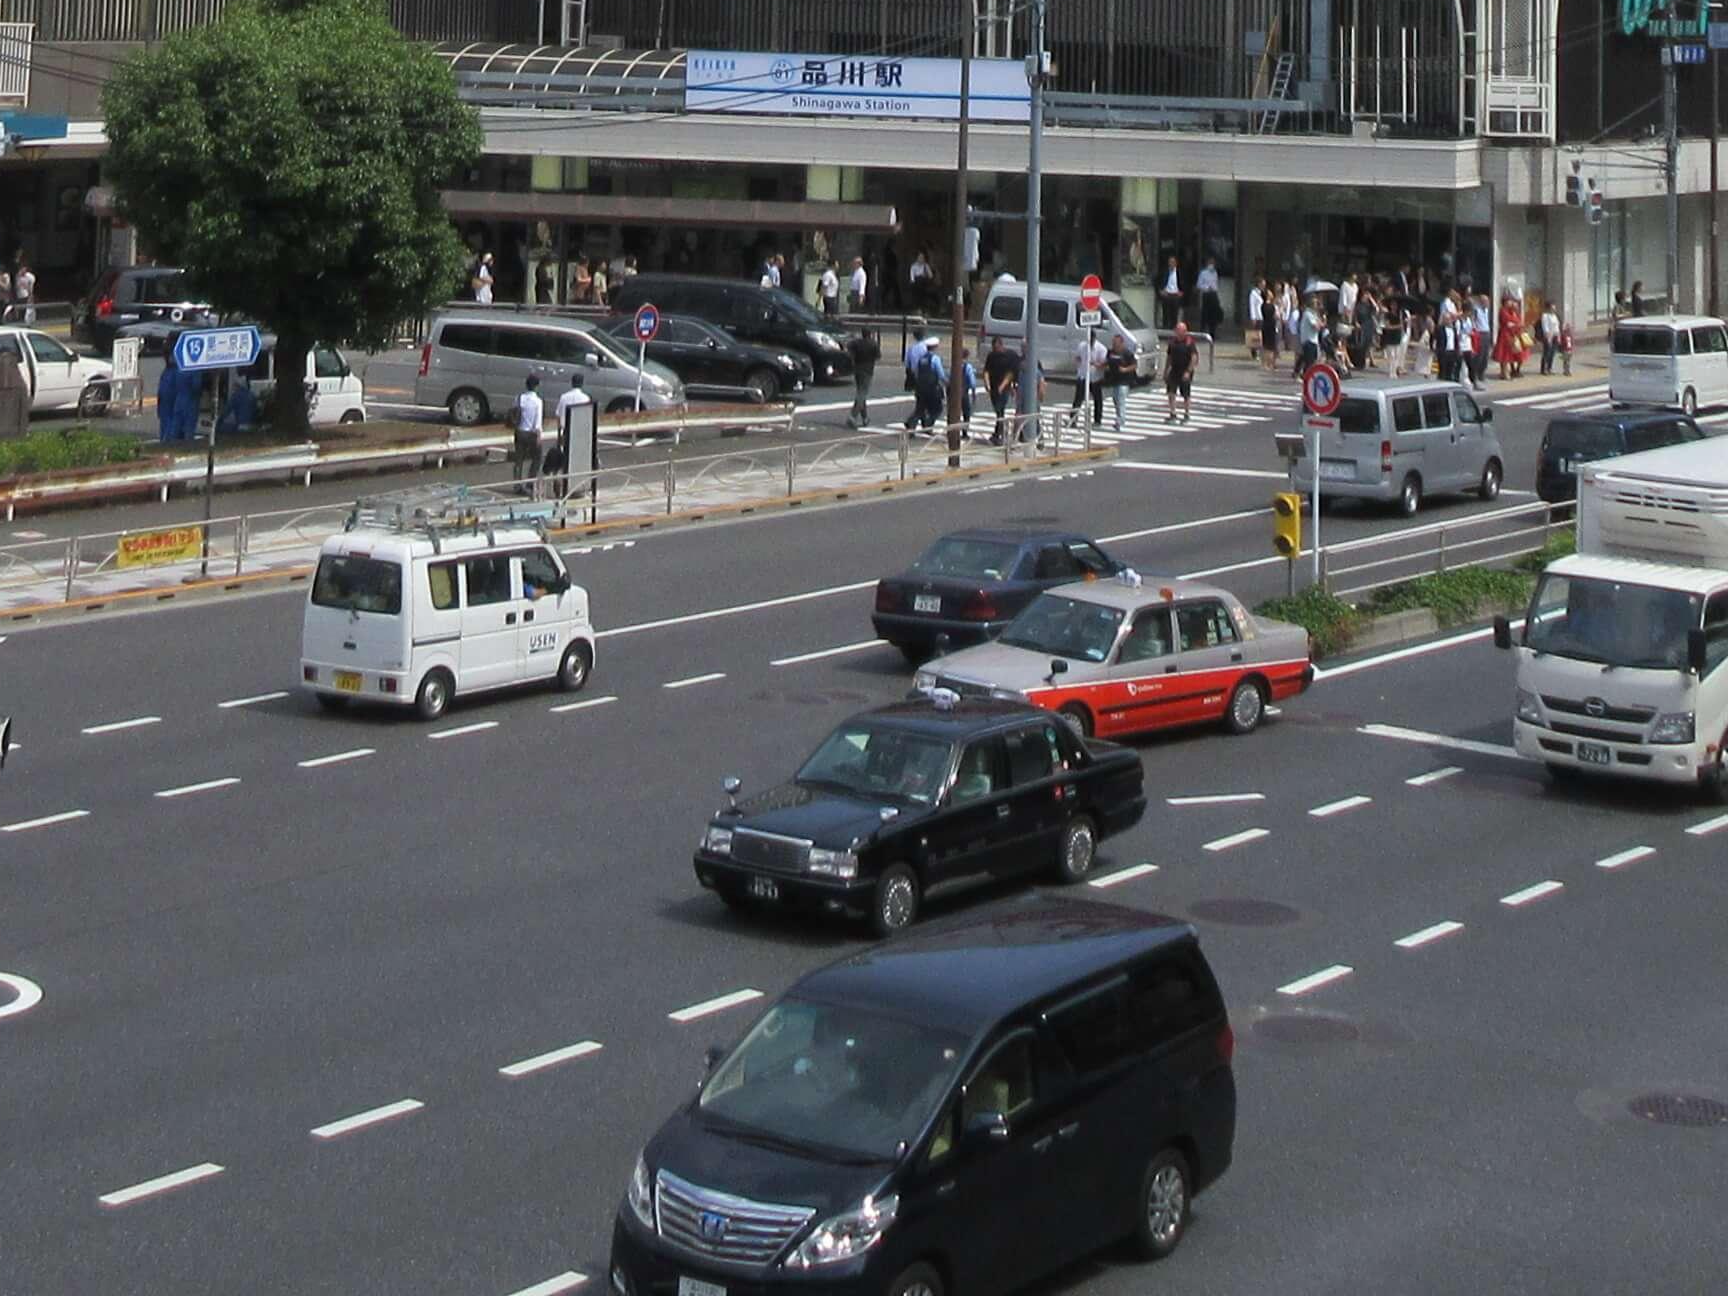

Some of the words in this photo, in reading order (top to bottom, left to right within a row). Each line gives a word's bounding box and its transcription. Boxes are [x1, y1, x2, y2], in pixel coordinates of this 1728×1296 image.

[801, 60, 903, 87] 品川駅
[791, 95, 862, 112] Shinagawa
[865, 98, 910, 112] Station
[189, 338, 201, 355] 15
[529, 632, 557, 648] USEN
